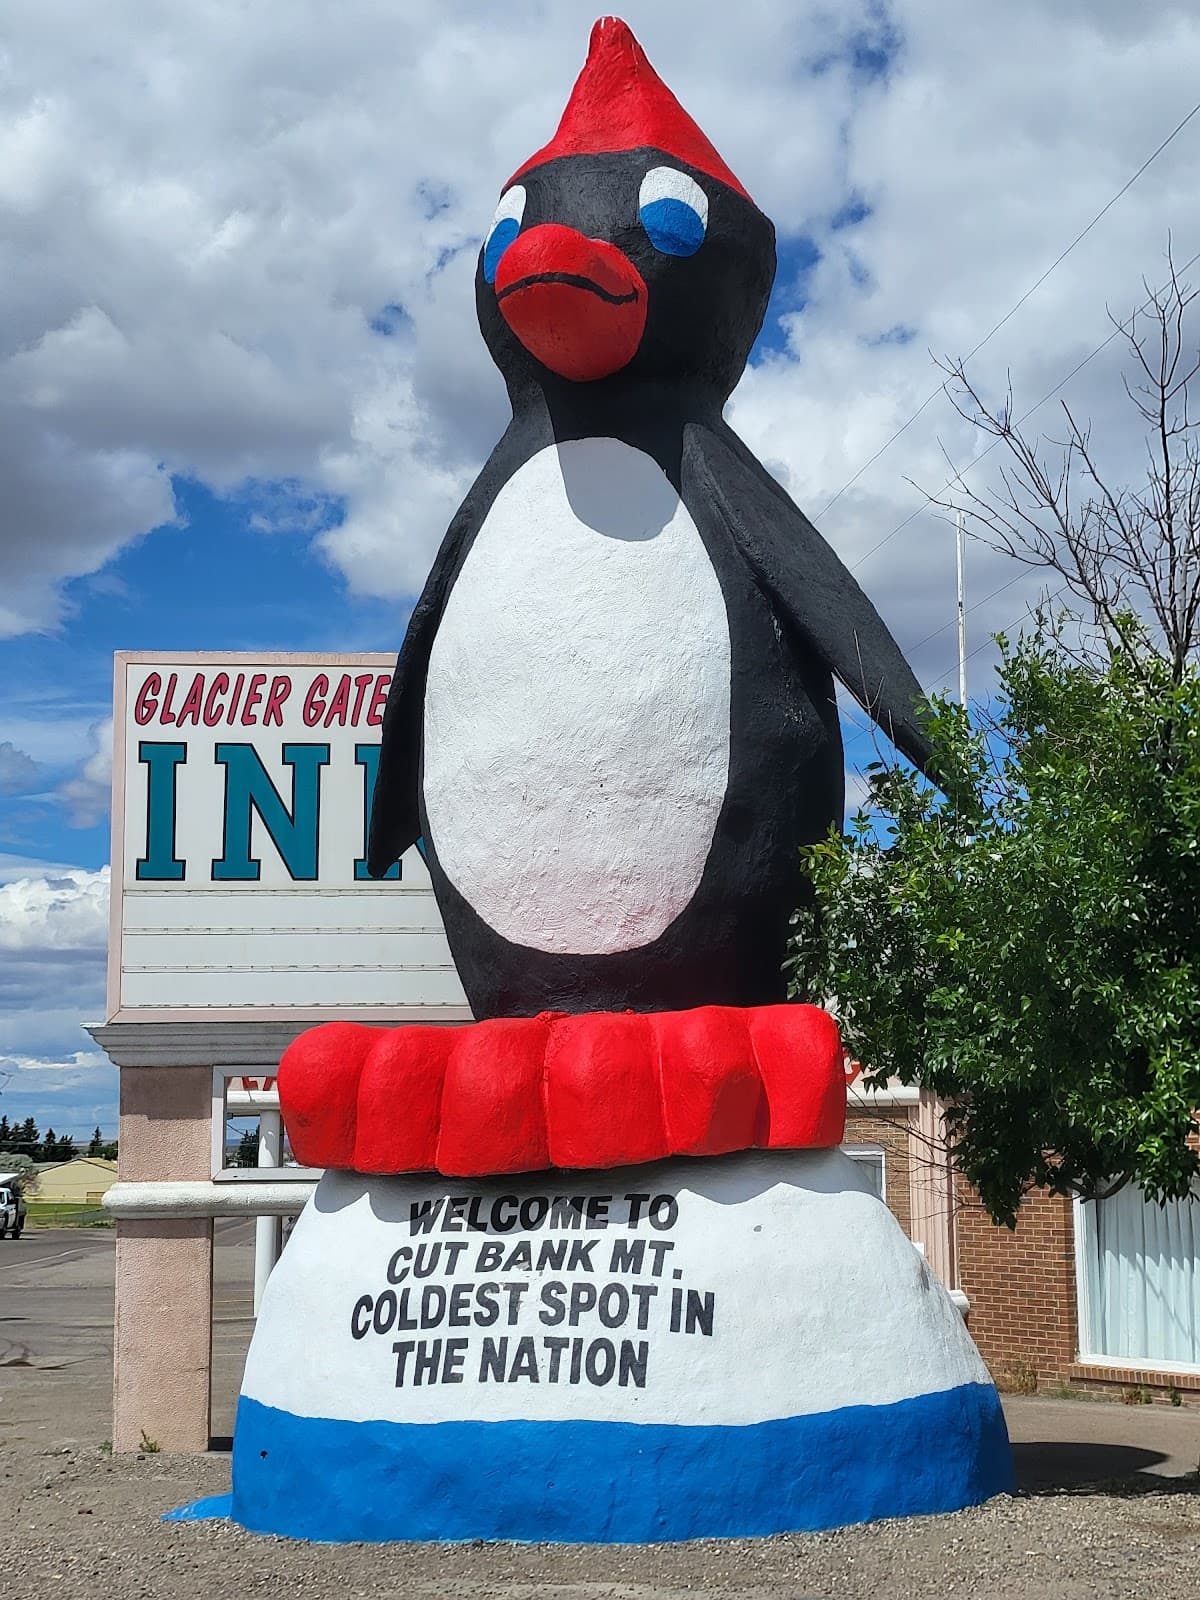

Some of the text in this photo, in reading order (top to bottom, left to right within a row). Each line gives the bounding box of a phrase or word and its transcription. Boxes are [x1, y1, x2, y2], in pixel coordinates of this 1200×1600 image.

[134, 672, 292, 728] GLACIER
[409, 1193, 679, 1236] WELCOME TO
[386, 1239, 684, 1285] CUT BANK MT.
[350, 1280, 715, 1340] COLDEST SPOT IN
[392, 1336, 649, 1388] THE NATION
